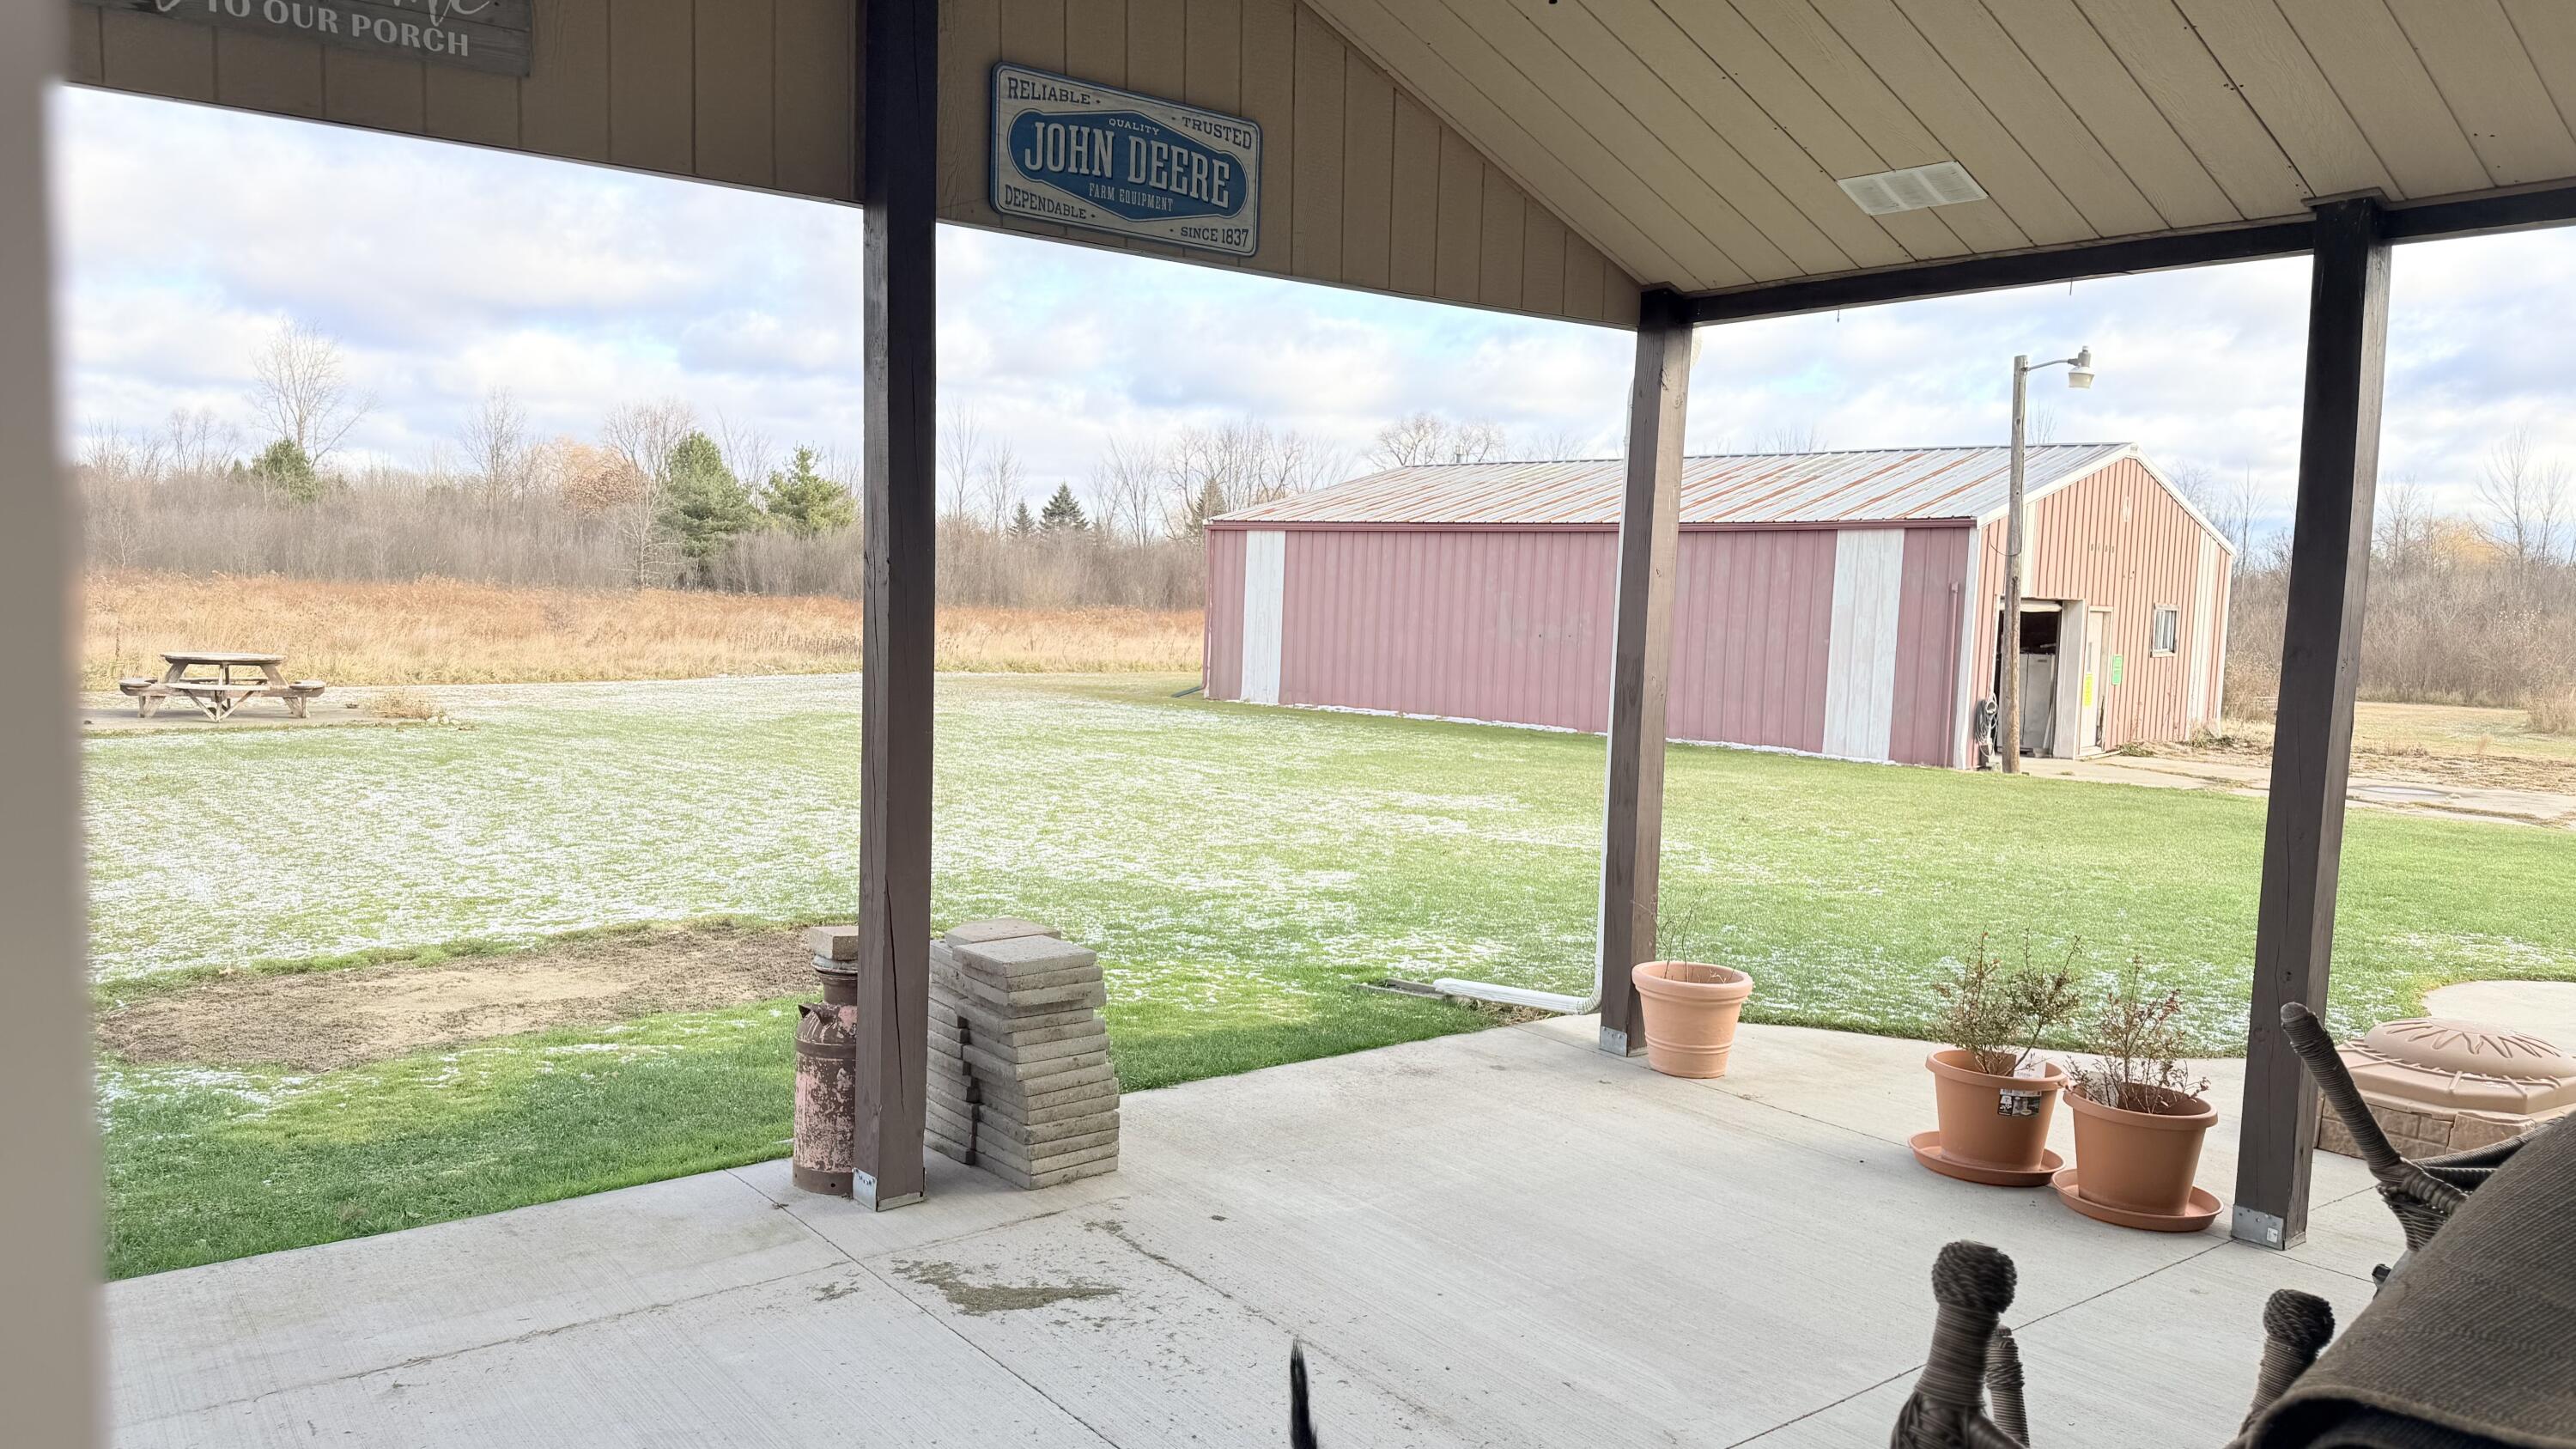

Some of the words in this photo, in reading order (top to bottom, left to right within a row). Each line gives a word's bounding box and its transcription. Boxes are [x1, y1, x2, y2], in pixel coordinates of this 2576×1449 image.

[263, 0, 338, 33] OUR
[352, 14, 468, 57] PORCH
[1008, 77, 1091, 105] RELIABLE
[1109, 118, 1159, 136] QUALITY
[1182, 117, 1252, 149] TRUSTED
[1024, 122, 1115, 179] JOHN
[1127, 135, 1230, 210] DEERE
[1005, 184, 1086, 220] DEPENDABLE
[1089, 183, 1115, 201] FARM
[1120, 189, 1174, 212] EQUIPMENT
[1181, 227, 1218, 242] SINCE
[1222, 228, 1249, 247] 1837
